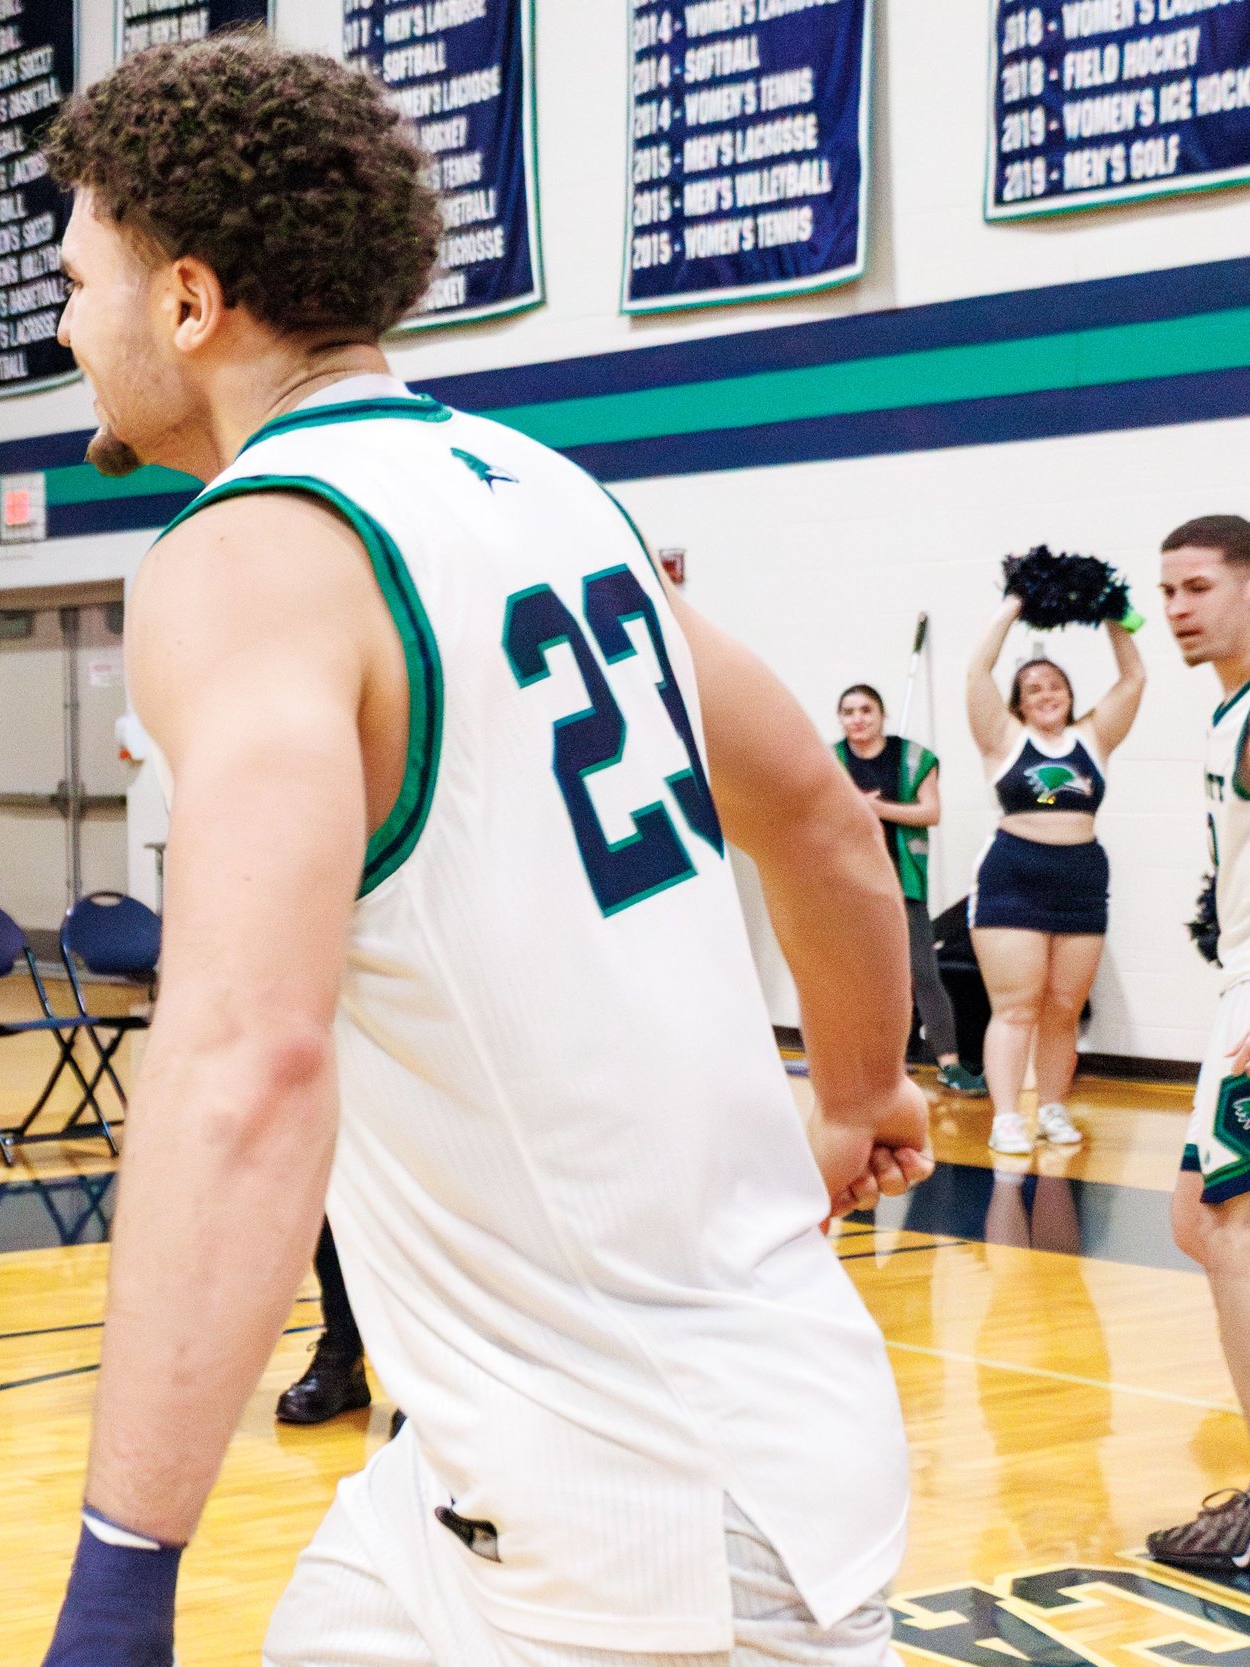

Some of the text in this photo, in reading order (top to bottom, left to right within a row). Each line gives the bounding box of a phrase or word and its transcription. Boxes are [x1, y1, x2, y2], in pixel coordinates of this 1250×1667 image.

[383, 39, 447, 82] SOFTBALL
[634, 10, 672, 51] 2014
[1063, 43, 1121, 91] FIELD
[1122, 25, 1201, 80] HOCKEY
[634, 53, 671, 96] 2014
[684, 34, 760, 84] SOFTBALL
[634, 98, 671, 139] 2014
[684, 79, 757, 127] WOMEN'S
[760, 66, 814, 112] TENNIS
[1063, 87, 1156, 140] WOMEN'S
[1158, 76, 1193, 125] ICE
[1196, 66, 1250, 117] HOCK
[443, 152, 481, 189] TENNIS
[633, 143, 672, 184] 2015
[683, 132, 734, 174] MEN'S
[735, 112, 818, 164] LACROSSE
[1002, 155, 1047, 201] 2019
[1063, 142, 1127, 191] MEN'S
[1129, 133, 1181, 181] GOLF
[633, 186, 672, 227] 2015
[683, 175, 734, 217] MEN'S
[735, 158, 833, 208] VOLLEYBALL
[632, 231, 672, 270] 2015
[684, 215, 755, 261] WOMEN'S
[756, 205, 814, 250] TENNIS
[501, 562, 725, 918] 23
